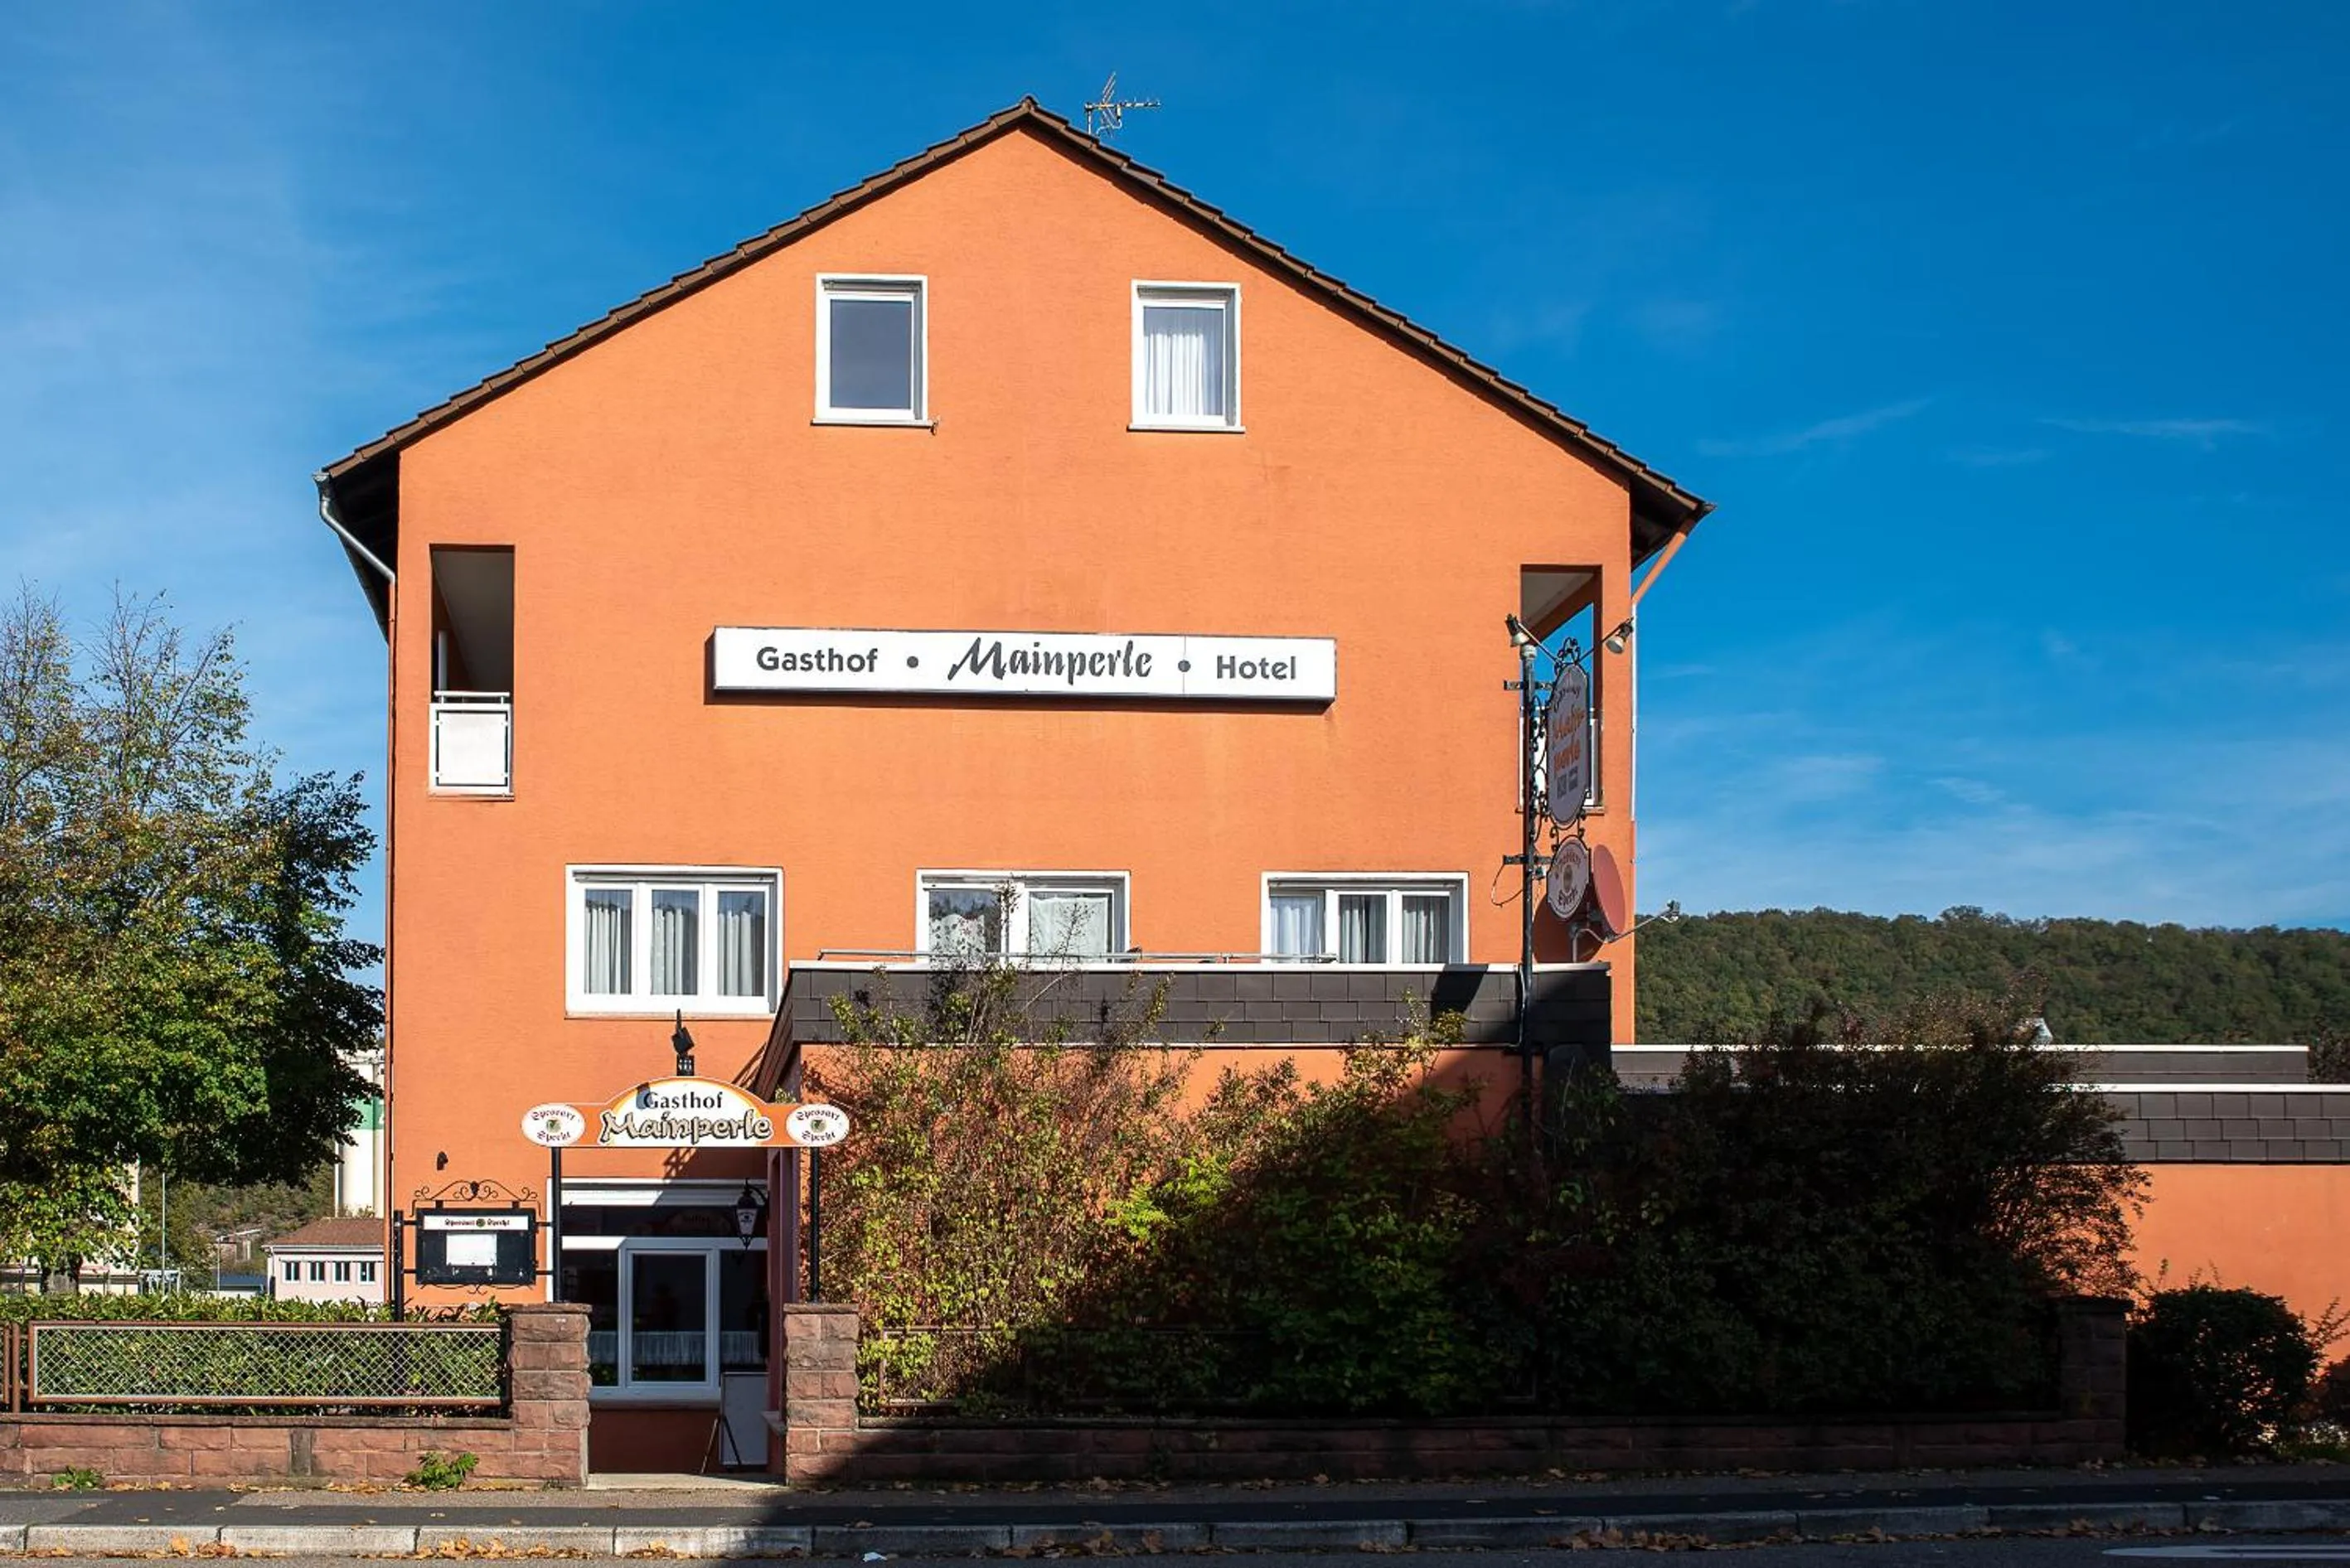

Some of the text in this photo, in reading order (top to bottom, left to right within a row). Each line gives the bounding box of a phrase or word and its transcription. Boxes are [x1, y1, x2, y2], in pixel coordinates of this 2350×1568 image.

[756, 636, 1296, 686] Gasthof Mainperle Hotel
[643, 1091, 724, 1109] Gasthof
[600, 1108, 772, 1145] Mainperle
